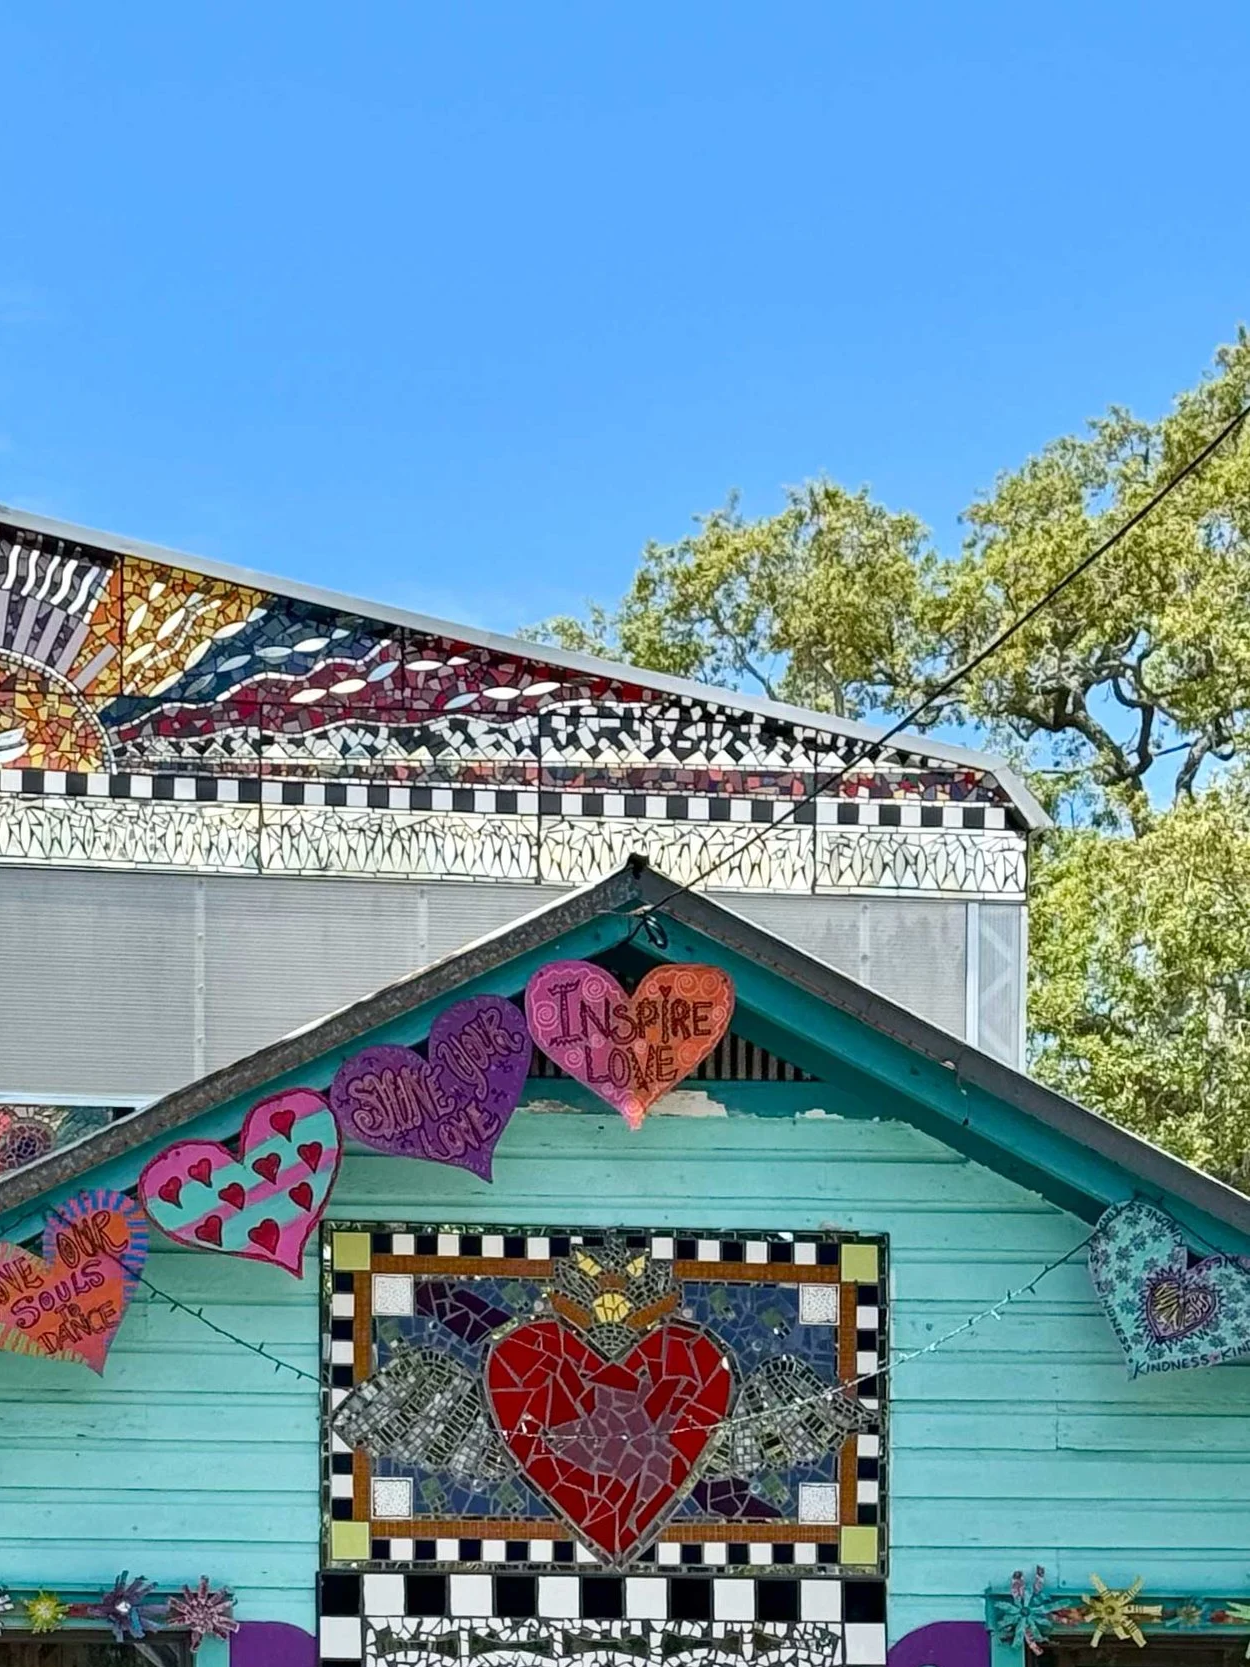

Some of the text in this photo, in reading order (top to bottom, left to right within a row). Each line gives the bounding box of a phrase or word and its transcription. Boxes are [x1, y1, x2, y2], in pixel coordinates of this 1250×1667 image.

[347, 1006, 525, 1141] SHINE YOUR
[585, 1045, 679, 1092] LOVE
[419, 1101, 501, 1160] LOVE
[56, 1210, 129, 1269] OUR
[10, 1259, 105, 1329] SOULS
[54, 1303, 82, 1321] TO
[37, 1300, 120, 1355] DANCE
[1132, 1355, 1211, 1380] KINDNESS
